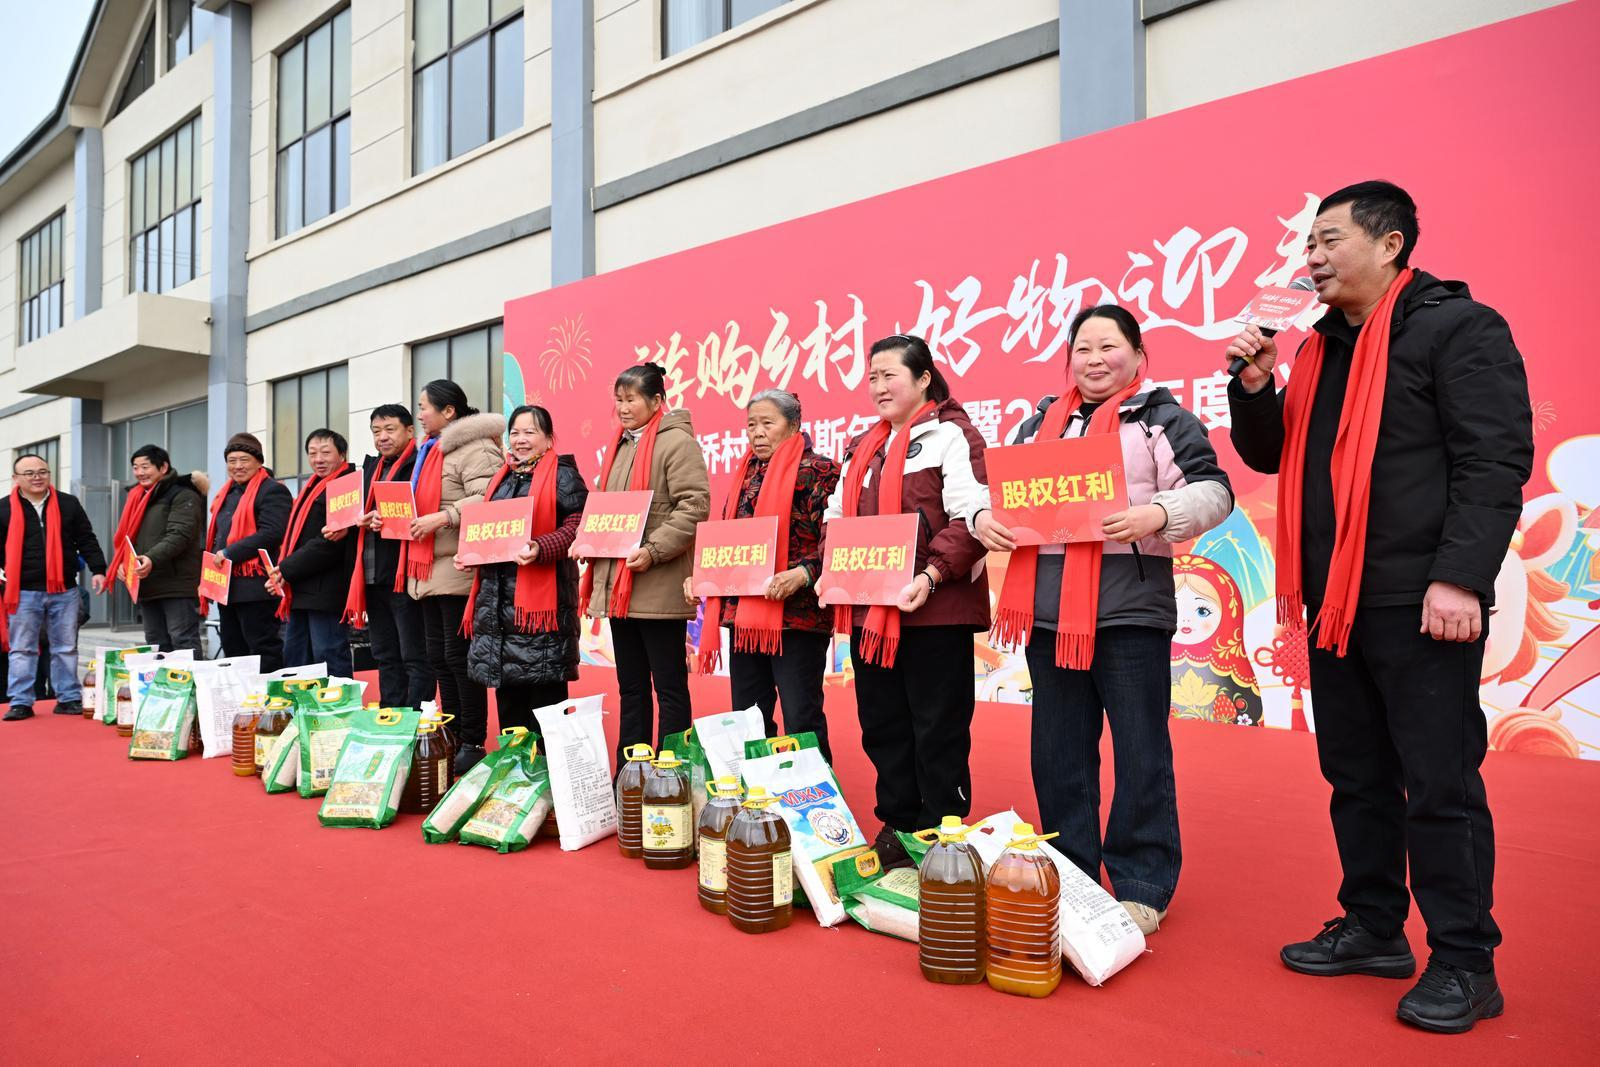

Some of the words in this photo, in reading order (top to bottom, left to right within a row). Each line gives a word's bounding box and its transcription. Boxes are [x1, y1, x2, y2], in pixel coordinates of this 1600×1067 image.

[1001, 470, 1115, 509] 股权红利
[466, 518, 525, 542] 股权红利
[584, 513, 640, 533] 股权红利
[701, 543, 768, 569] 股权红利
[830, 545, 907, 571] 股权红利
